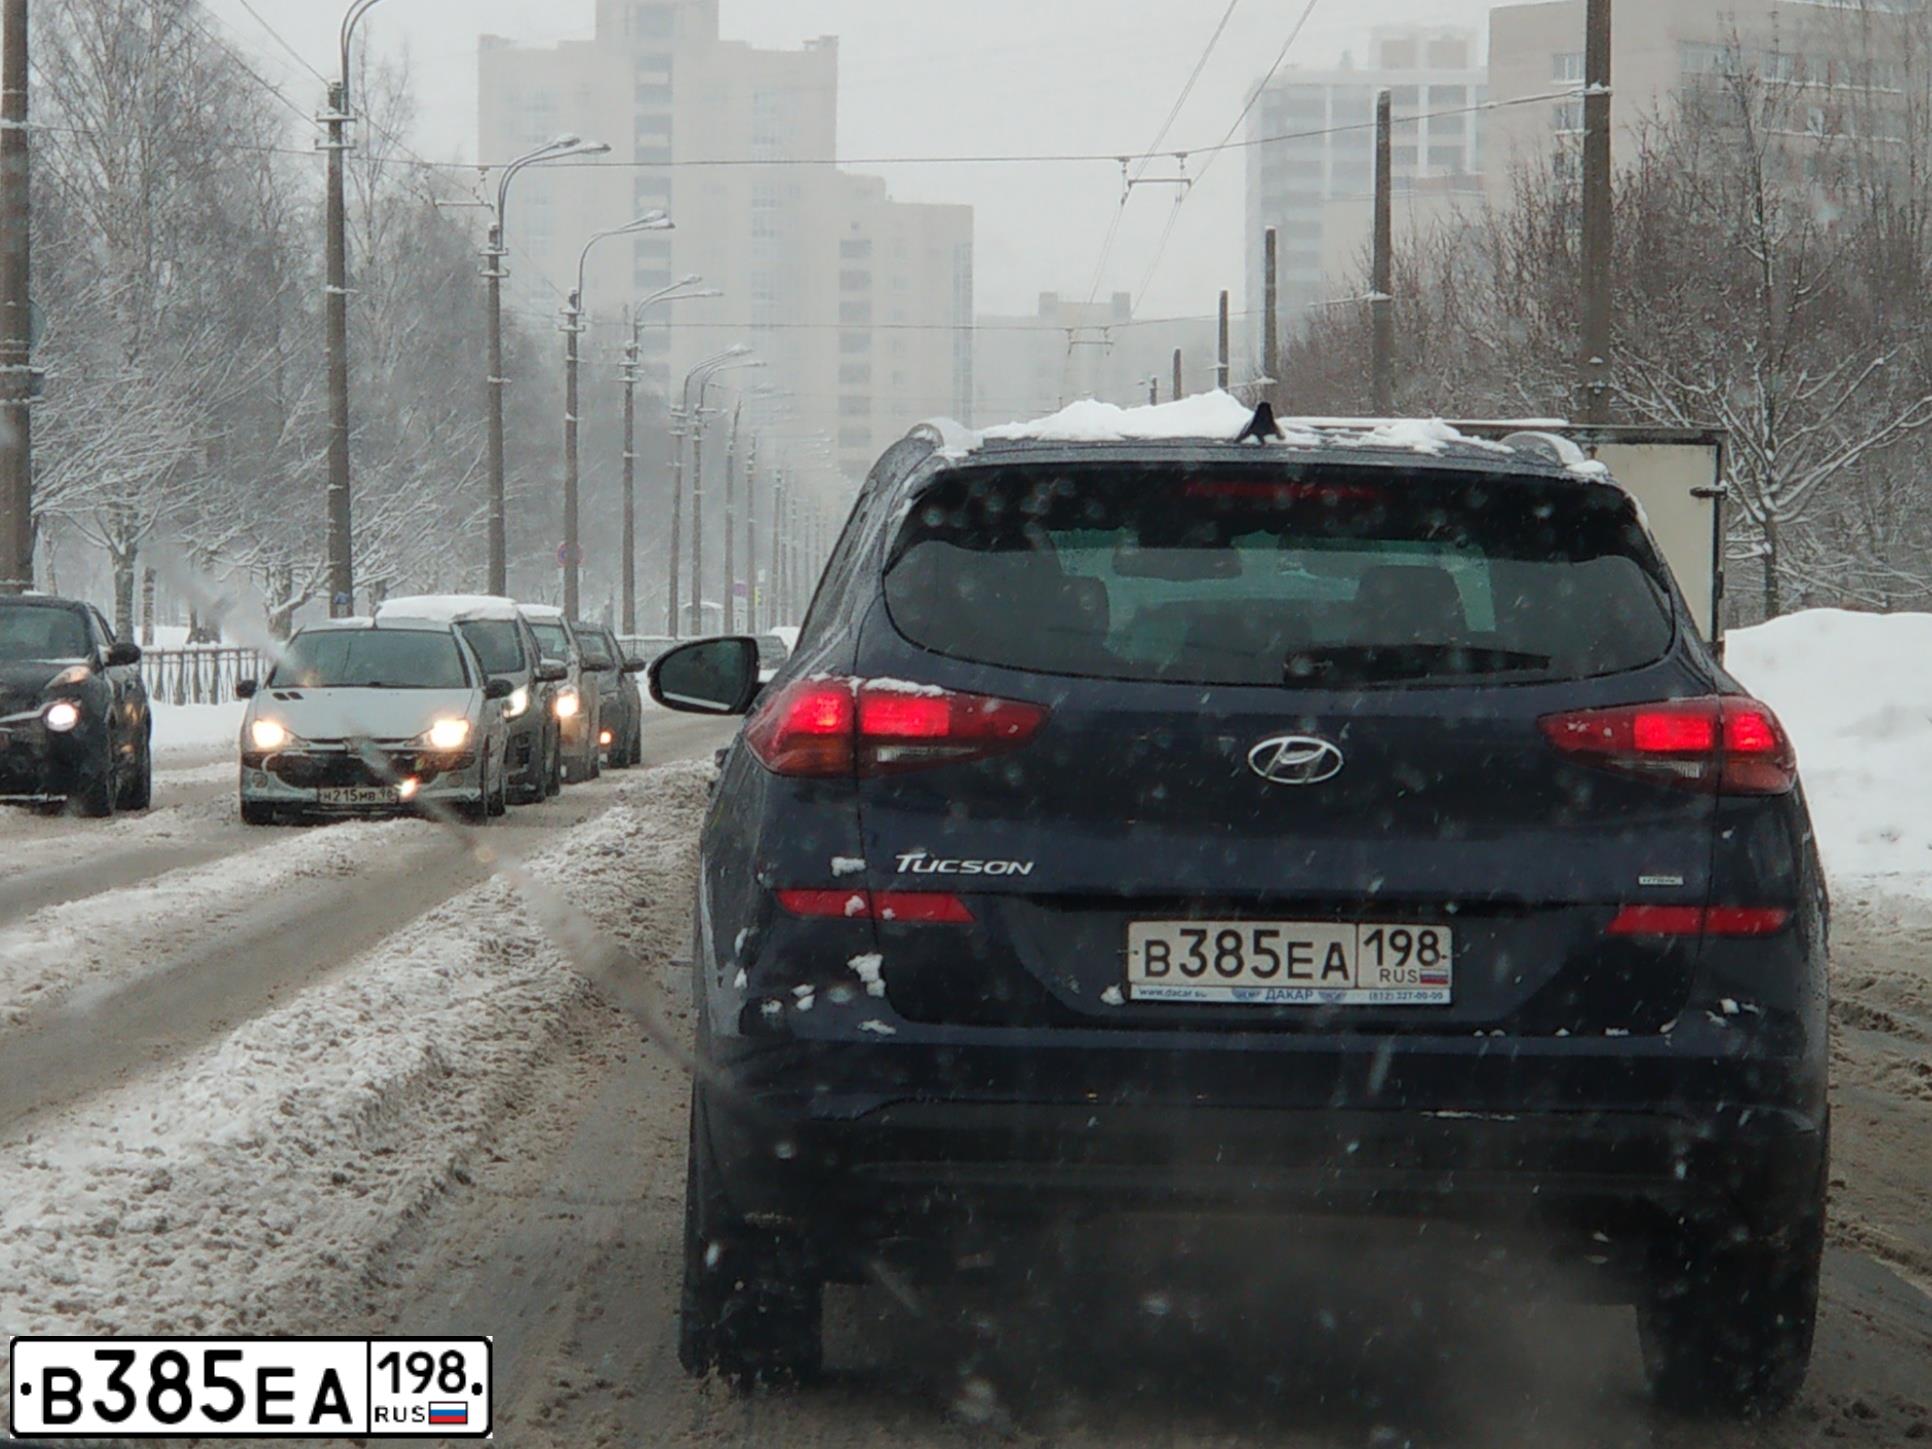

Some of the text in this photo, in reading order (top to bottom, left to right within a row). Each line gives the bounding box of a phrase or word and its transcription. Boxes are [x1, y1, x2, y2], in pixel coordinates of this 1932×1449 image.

[895, 852, 1035, 876] TUCSON
[1144, 928, 1440, 981] В385ЕА 198
[1379, 970, 1418, 984] RUS
[1264, 988, 1314, 1001] ДАКАР
